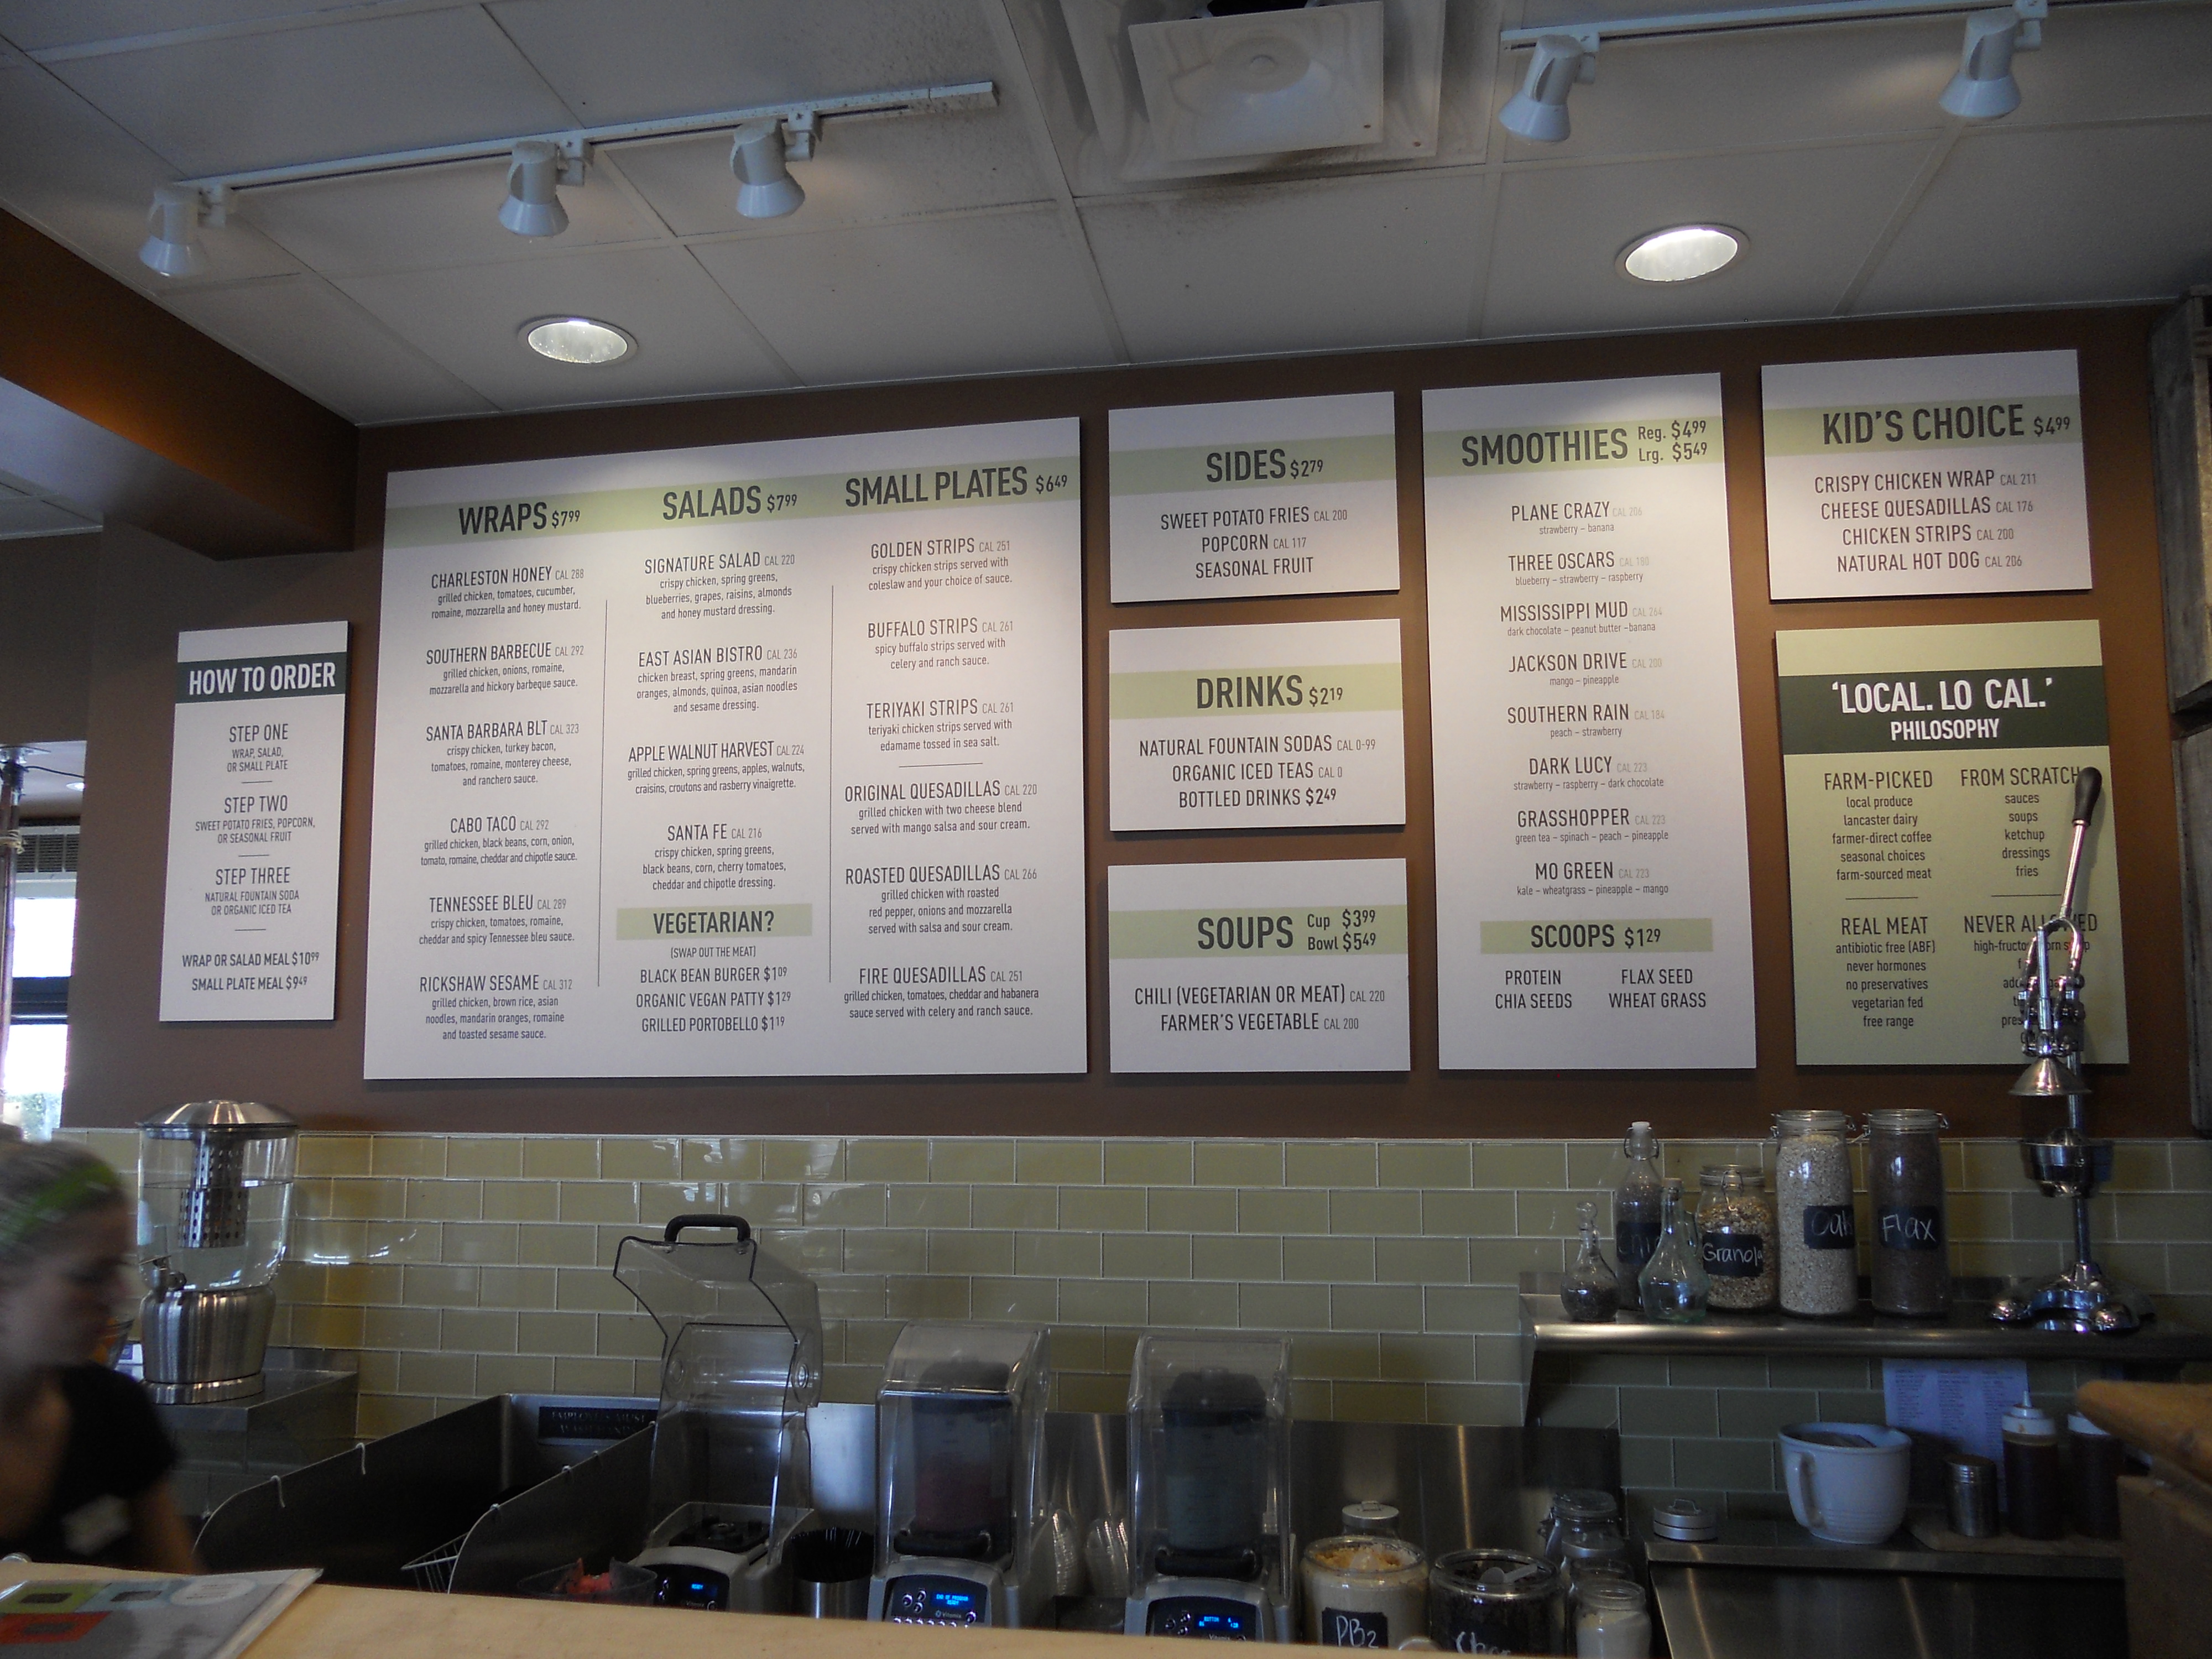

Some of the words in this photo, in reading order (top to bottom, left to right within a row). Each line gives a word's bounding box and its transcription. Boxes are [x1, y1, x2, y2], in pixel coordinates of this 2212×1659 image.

[1637, 426, 1666, 442] Reg.
[1823, 410, 1903, 445] KID'S
[1912, 404, 2025, 441] CHOICE
[1462, 427, 1628, 467] SMOOTHIES
[1639, 447, 1664, 465] Lrg.
[1206, 448, 1286, 483] SIDES
[846, 473, 928, 507] SMALL
[935, 466, 1027, 500] PLATES
[662, 485, 761, 520] SALADS
[458, 501, 547, 535] WRAPS
[871, 540, 922, 559] GOLDEN
[927, 537, 974, 555] STRIPS
[979, 541, 994, 552] CAL
[997, 540, 1009, 551] 251
[1202, 533, 1268, 553] POPCORN
[1273, 538, 1289, 549] CAL
[1292, 537, 1306, 548] 117
[644, 555, 714, 574] SIGNATURE
[719, 551, 760, 569] SALAD
[764, 555, 779, 566] CAL
[781, 554, 795, 565] 220
[1196, 559, 1269, 578] SEASONAL
[1274, 556, 1313, 575] FRUIT
[1837, 554, 1908, 572] NATURAL
[1913, 552, 1942, 570] HOT
[1948, 551, 1979, 568] DOG
[1985, 556, 2002, 567] CAL
[2006, 555, 2022, 567] 206
[431, 568, 508, 589] CHARLESTON
[512, 565, 552, 583] HONEY
[555, 570, 568, 580] CAL
[571, 568, 584, 579] 288
[437, 592, 462, 606] grilled
[463, 590, 495, 602] chicken,
[497, 588, 534, 599] tomatoes,
[536, 585, 575, 597] cucumber,
[1500, 602, 1590, 622] MISSISSIPPI
[1595, 601, 1628, 619] MUD
[1632, 607, 1646, 617] CAL
[1649, 607, 1662, 617] 264
[639, 650, 669, 667] EAST
[672, 648, 711, 665] ASIAN
[716, 645, 763, 662] BISTRO
[766, 649, 781, 660] CAL
[784, 648, 797, 659] 236
[875, 643, 896, 656] spicy
[899, 641, 928, 653] buffalo
[930, 640, 955, 653] strips
[957, 638, 985, 650] served
[987, 637, 1005, 648] with
[189, 667, 238, 695] HOW
[241, 666, 265, 692] TO
[270, 661, 336, 691] ORDER
[1197, 674, 1303, 709] DRINKS
[1939, 680, 1972, 710] LO
[229, 724, 260, 743] STEP
[263, 723, 288, 741] ONE
[1890, 718, 2000, 740] PHILOSOPHY
[232, 748, 255, 759] WRAP,
[257, 747, 283, 758] SALAD,
[1172, 764, 1235, 782] ORGANIC
[1241, 762, 1273, 780] ICED
[1277, 761, 1313, 779] TEAS
[1318, 766, 1334, 778] CAL
[1824, 770, 1932, 790] FARM-PICKED
[1960, 768, 2005, 786] FROM
[2010, 766, 2079, 785] SCRATCH
[844, 784, 906, 802] ORIGINAL
[910, 780, 1000, 800] QUESADILLAS
[1004, 785, 1020, 796] CAL
[1022, 784, 1037, 795] 220
[1179, 790, 1240, 808] BOTTLED
[1246, 788, 1300, 806] DRINKS
[2004, 794, 2039, 804] sauces
[224, 796, 255, 813] STEP
[258, 795, 288, 812] TWO
[1846, 796, 1871, 808] local
[1874, 795, 1913, 810] produce
[450, 817, 482, 833] CABO
[486, 815, 516, 832] TACO
[520, 820, 534, 831] CAL
[536, 820, 549, 830] 292
[1517, 807, 1630, 828] GRASSHOPPER
[1635, 815, 1649, 825] CAL
[1652, 815, 1665, 825] 223
[215, 868, 246, 885] STEP
[250, 866, 290, 884] THREE
[205, 891, 238, 902] NATURAL
[240, 890, 277, 901] FOUNTAIN
[279, 889, 299, 901] SODA
[653, 910, 774, 934] VEGETARIAN?
[868, 922, 896, 934] served
[898, 922, 917, 933] with
[919, 921, 942, 933] salsa
[944, 920, 959, 932] and
[962, 923, 981, 932] sour
[983, 922, 1013, 932] cream.
[1307, 913, 1330, 931] Cup
[1841, 917, 1881, 935] REAL
[1886, 916, 1928, 935] MEAT
[419, 933, 450, 945] cheddar
[451, 933, 465, 944] and
[467, 933, 487, 946] spicy
[489, 932, 529, 943] Tennessee
[530, 931, 547, 942] bleu
[549, 933, 575, 942] sauce.
[1198, 915, 1293, 950] SOUPS
[1531, 924, 1615, 948] SCOOPS
[1307, 936, 1339, 951] Bowl
[181, 954, 212, 967] WRAP
[213, 954, 227, 967] OR
[229, 953, 262, 966] SALAD
[263, 952, 290, 966] MEAL
[1846, 962, 1874, 972] never
[1876, 959, 1927, 972] hormones
[191, 977, 224, 991] SMALL
[226, 977, 255, 990] PLATE
[258, 977, 284, 990] MEAL
[420, 975, 486, 992] RICKSHAW
[489, 974, 539, 991] SESAME
[542, 979, 556, 990] CAL
[559, 979, 572, 990] 312
[640, 968, 677, 983] BLACK
[681, 968, 710, 983] BEAN
[714, 967, 760, 982] BURGER
[1505, 969, 1561, 985] PROTEIN
[1608, 992, 1656, 1008] WHEAT
[1661, 992, 1706, 1008] GRASS
[641, 1017, 686, 1032] GRILLED
[689, 1016, 758, 1031] PORTOBELLO
[1161, 1013, 1233, 1031] FARMER'S
[1238, 1013, 1319, 1030] VEGETABLE
[1323, 1018, 1340, 1030] CAL
[1343, 1018, 1359, 1029] 200
[1882, 1214, 1936, 1242] Flax
[1703, 1243, 1763, 1267] Granola
[1336, 1615, 1379, 1647] PB2
